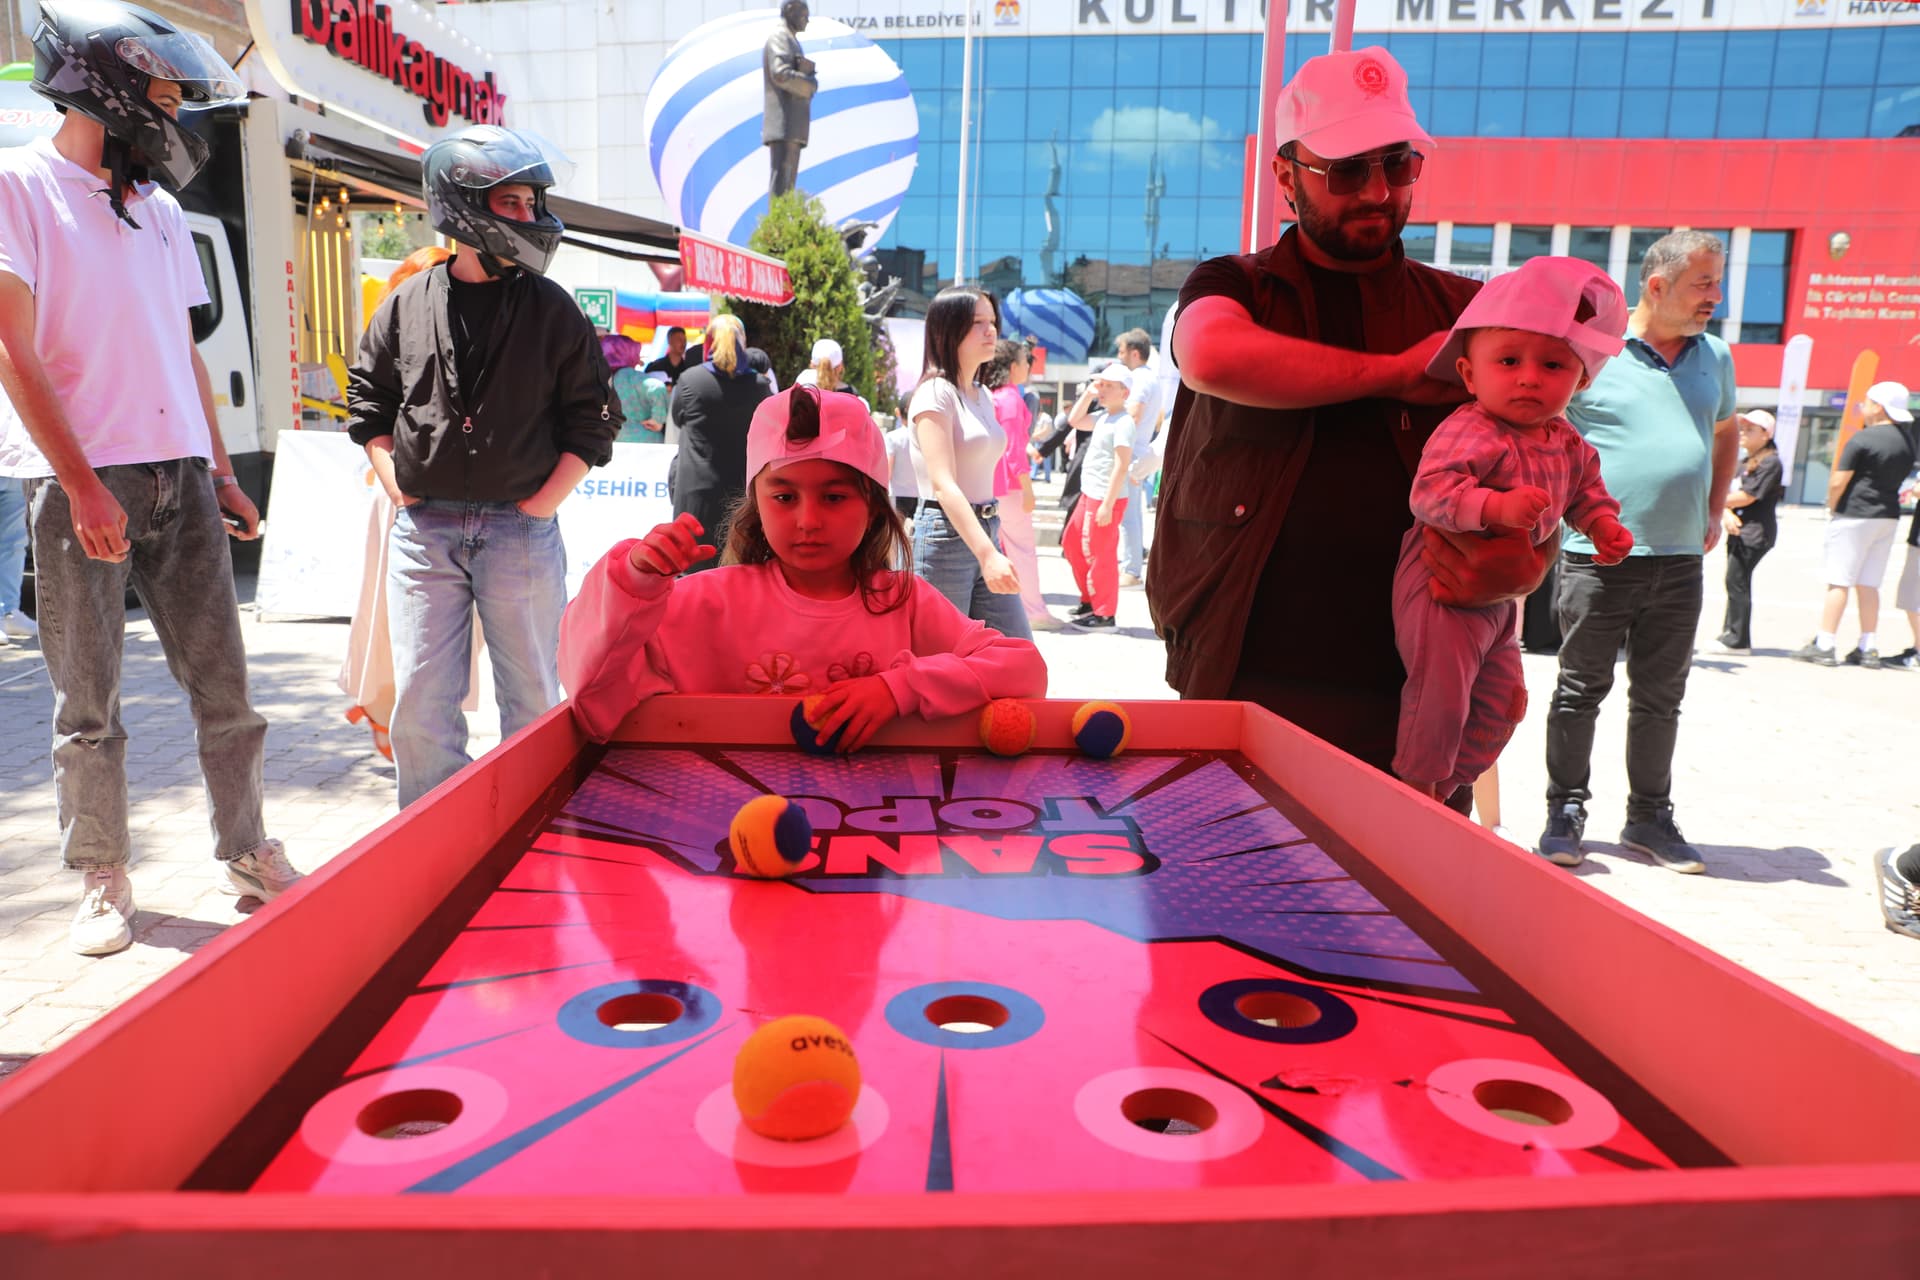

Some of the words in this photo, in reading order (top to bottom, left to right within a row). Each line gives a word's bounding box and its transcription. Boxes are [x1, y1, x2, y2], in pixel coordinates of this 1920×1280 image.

[1848, 1, 1920, 15] HAVZA
[831, 16, 878, 29] AVZA
[884, 11, 981, 29] BELEDİYEİ
